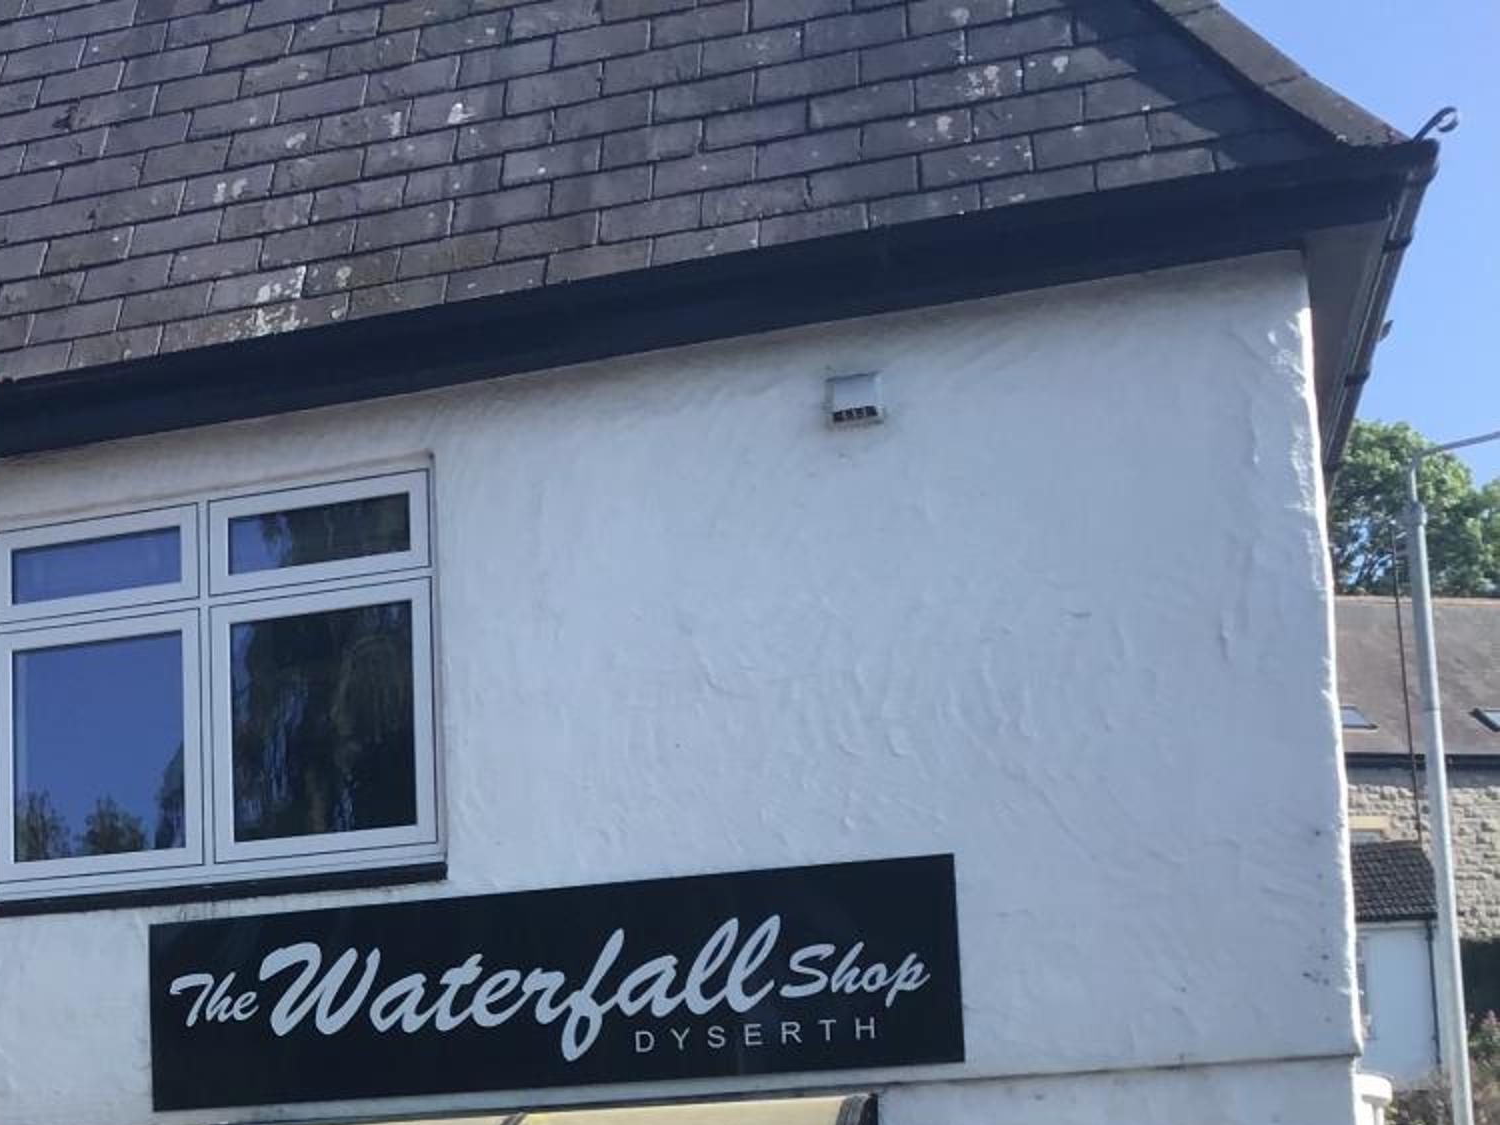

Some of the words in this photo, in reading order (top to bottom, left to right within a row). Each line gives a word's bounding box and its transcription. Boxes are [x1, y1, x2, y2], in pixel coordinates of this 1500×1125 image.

[169, 973, 258, 1029] The
[256, 914, 781, 1062] Waterfall
[780, 941, 931, 1005] Shop
[635, 1015, 878, 1054] DYSERTH
